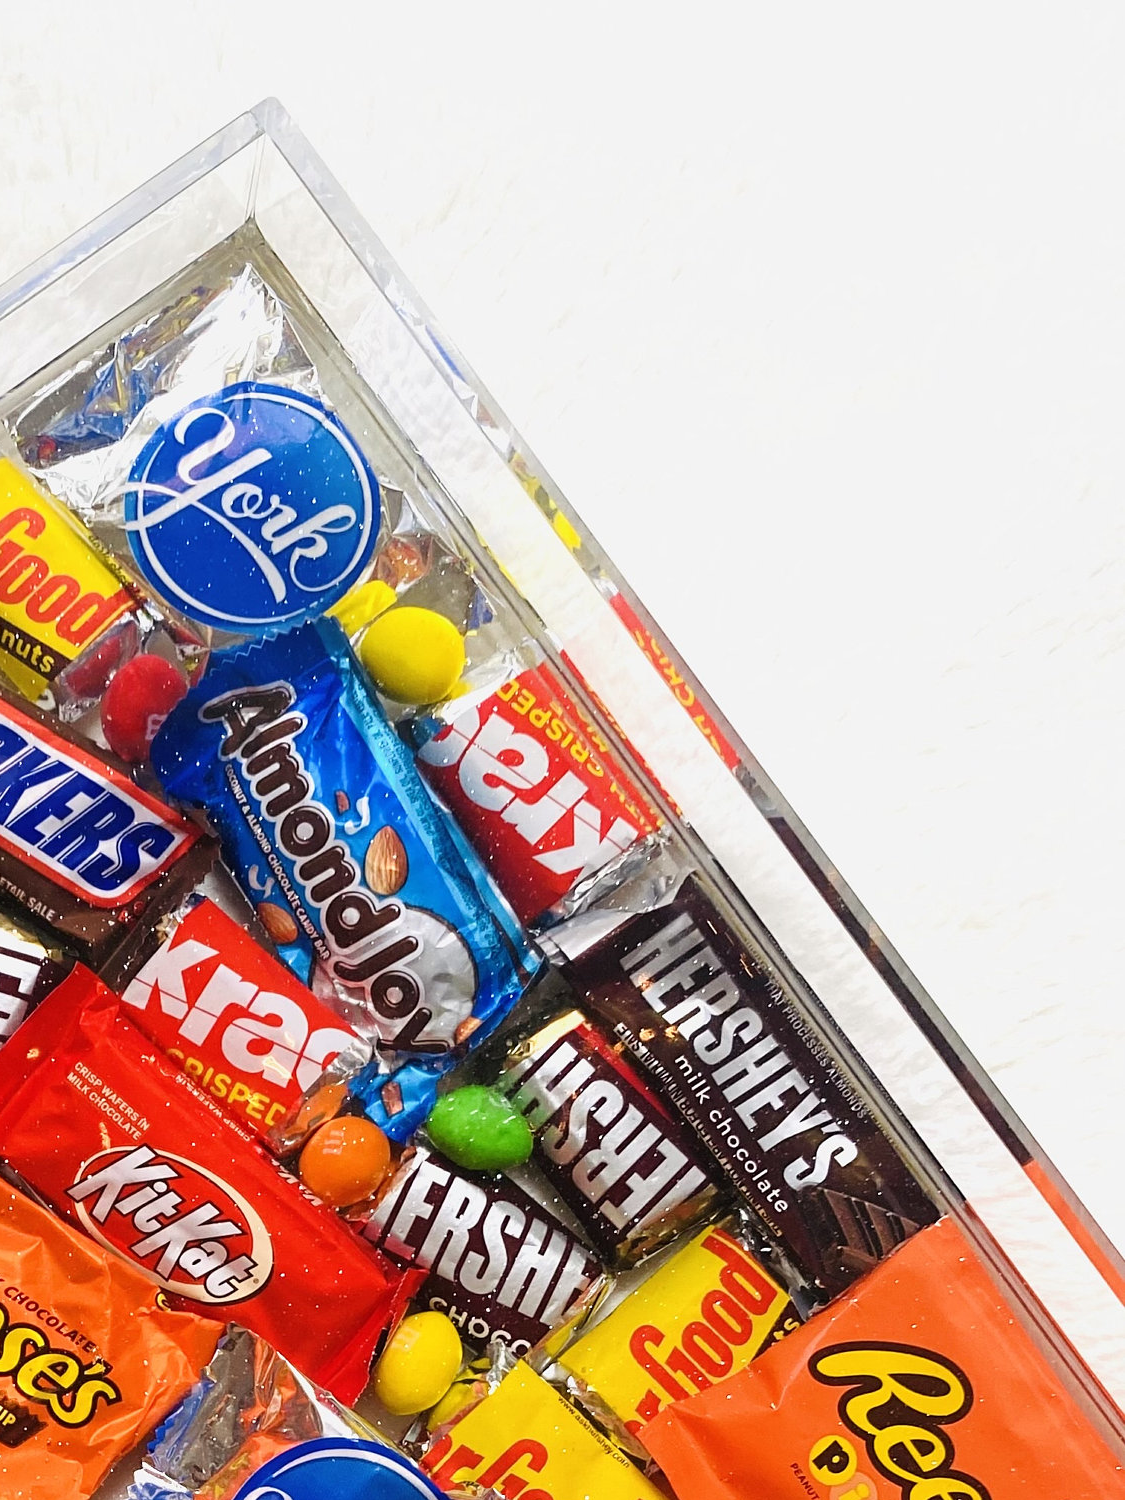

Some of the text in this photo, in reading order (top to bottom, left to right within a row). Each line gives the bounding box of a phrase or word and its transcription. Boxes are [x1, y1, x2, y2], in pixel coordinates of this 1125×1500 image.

[101, 408, 357, 602] York
[496, 679, 604, 777] CRISPED
[200, 684, 402, 950] Almond
[224, 763, 330, 961] COCONUT ALMOND CHOCOLATE CANDY BAR
[27, 897, 55, 922] SALE
[74, 1061, 138, 1122] CRISP WAFERS
[620, 912, 858, 1191] HERSHEY'S
[67, 1073, 143, 1141] MILK CHOCOLATE
[675, 1053, 788, 1213] milk chocolate
[4, 1286, 98, 1355] CHOCOLATE
[790, 1462, 820, 1500] PEANUT
